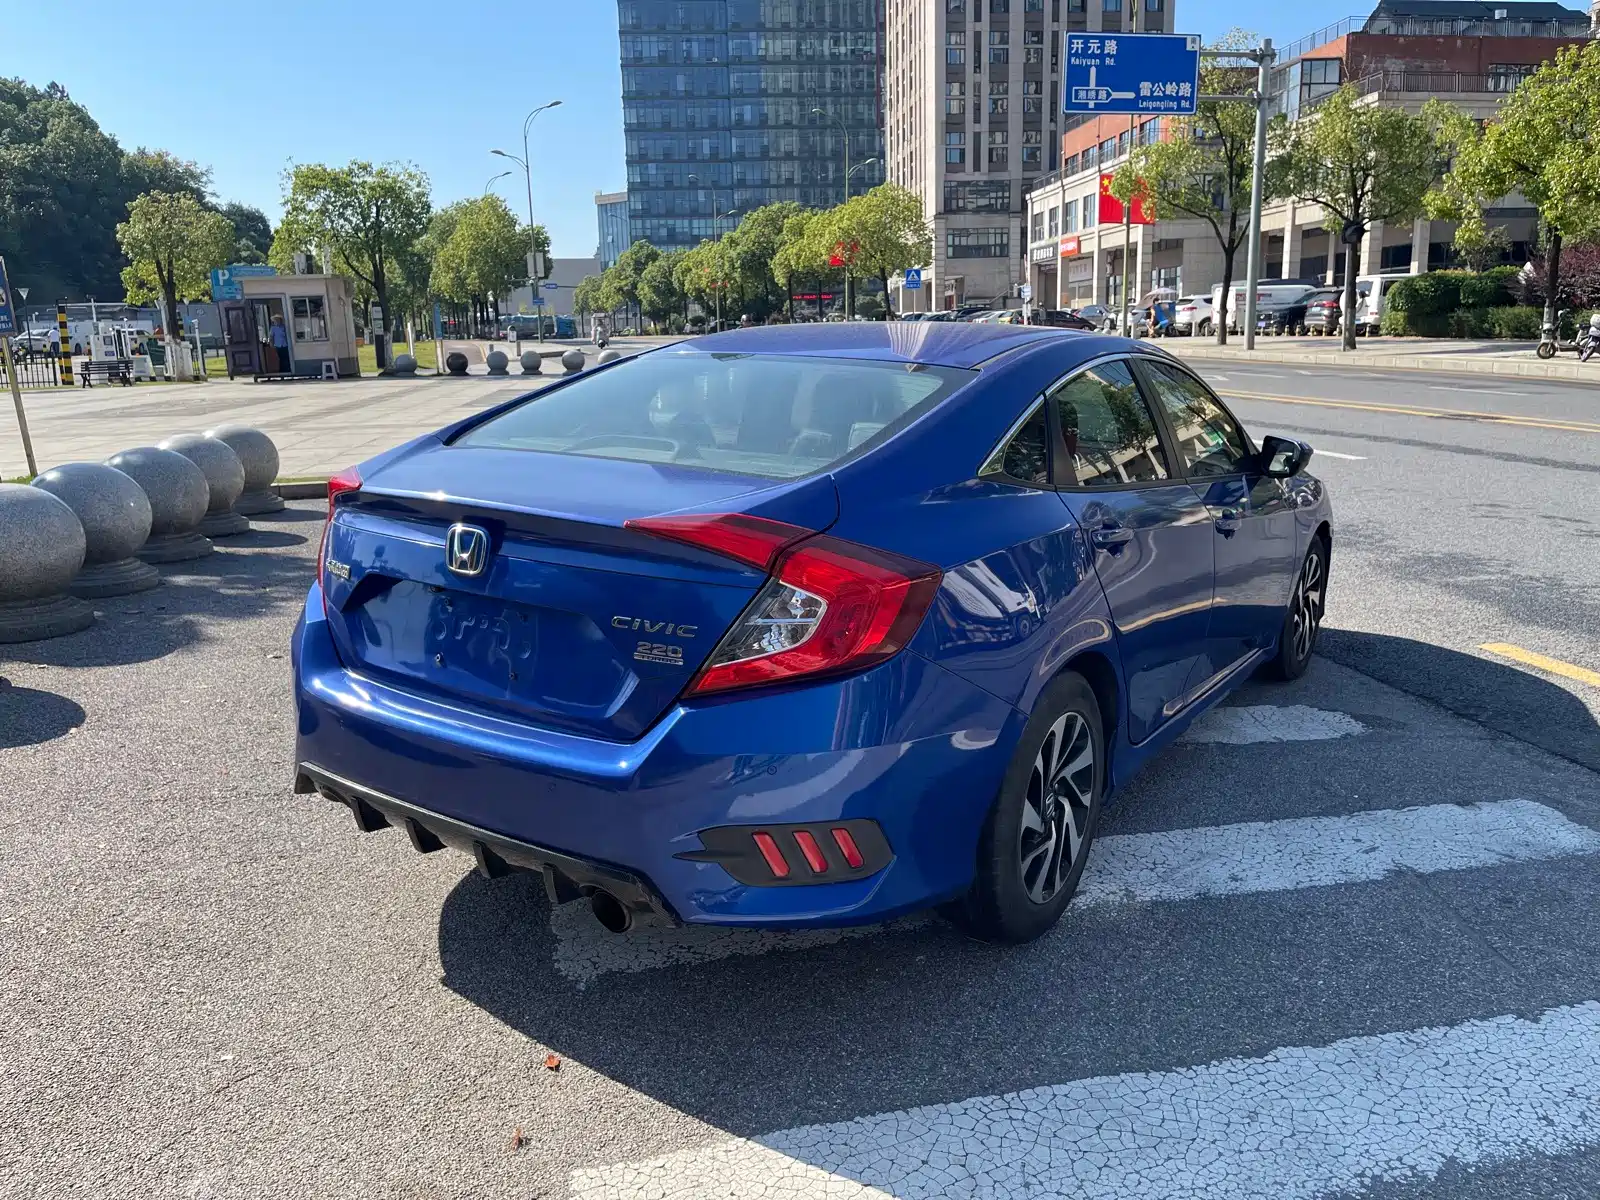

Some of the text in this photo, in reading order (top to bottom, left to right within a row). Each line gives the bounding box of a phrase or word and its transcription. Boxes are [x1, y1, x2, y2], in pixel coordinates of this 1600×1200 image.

[1070, 39, 1118, 55] 开元路
[1070, 56, 1117, 67] Kaiyuan Rd.
[1139, 81, 1192, 97] 雷公岭路
[1138, 100, 1192, 110] Leigongling Rd.
[218, 269, 230, 286] P
[611, 615, 698, 638] CIVIC
[636, 641, 683, 658] 220
